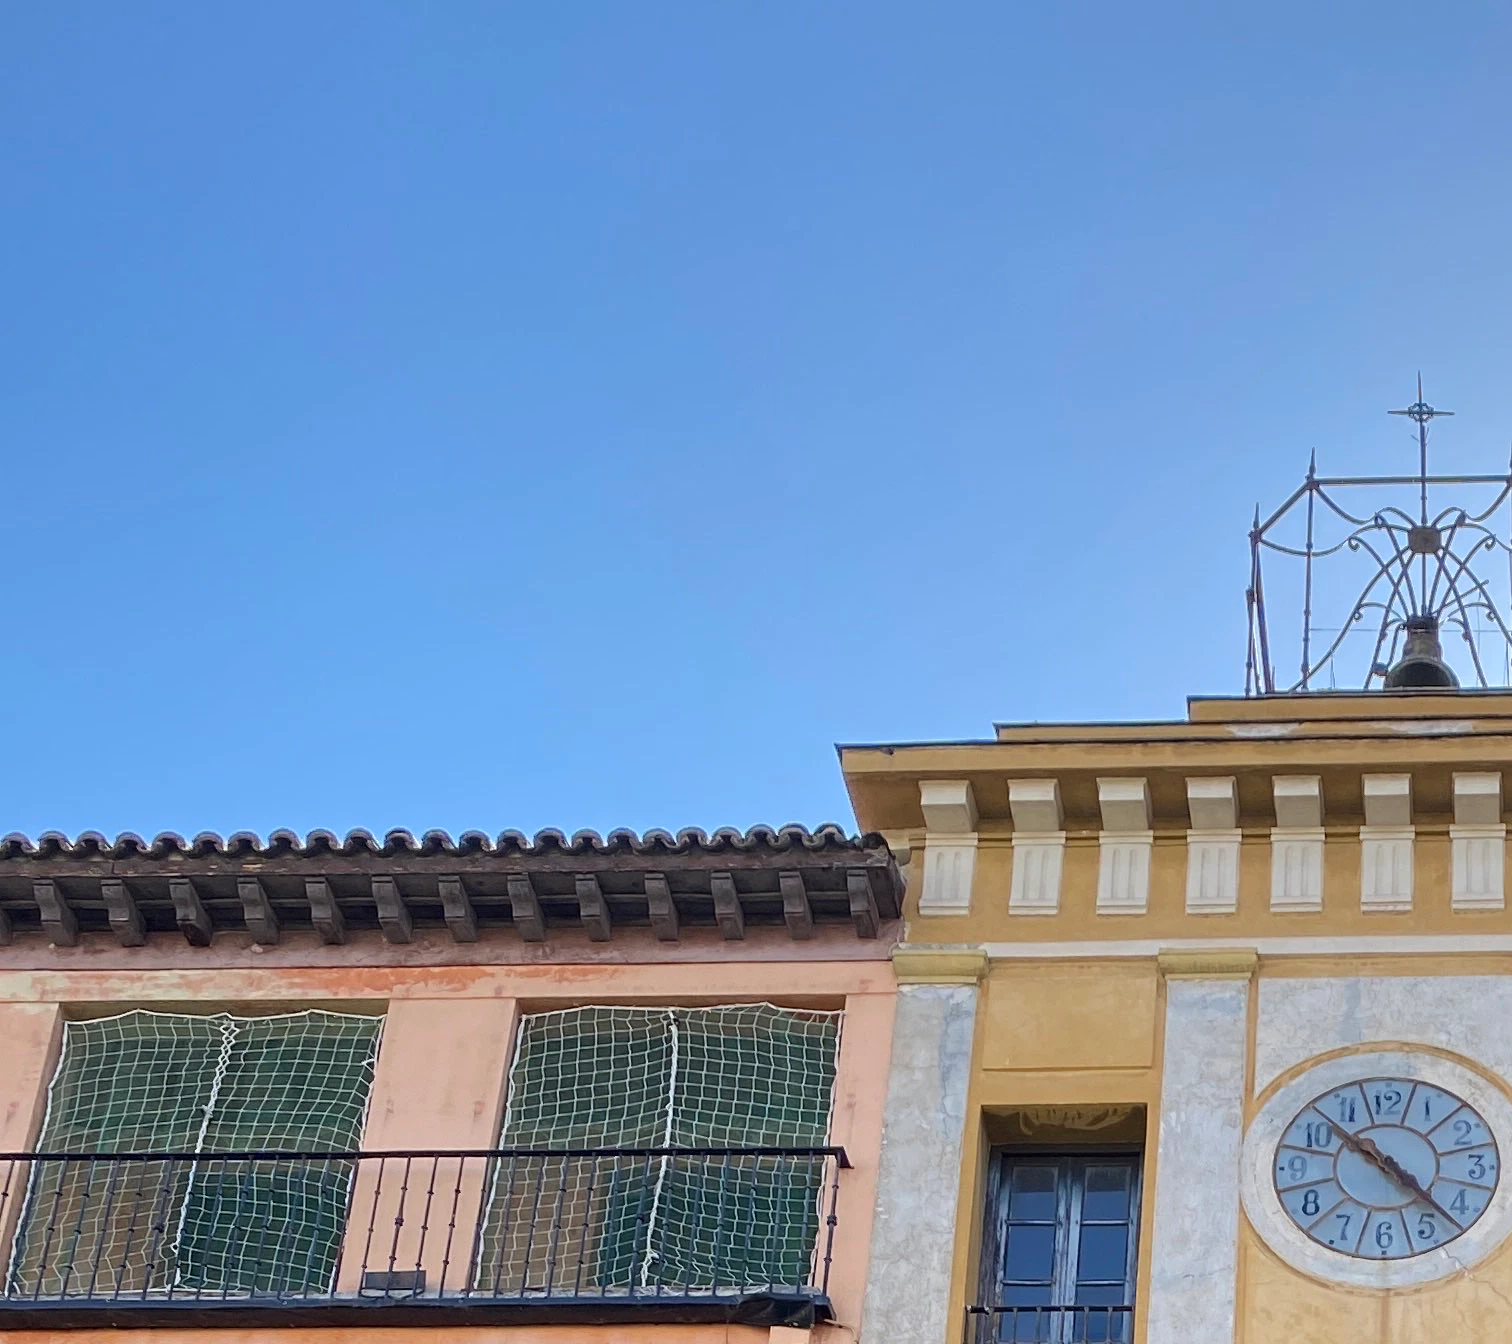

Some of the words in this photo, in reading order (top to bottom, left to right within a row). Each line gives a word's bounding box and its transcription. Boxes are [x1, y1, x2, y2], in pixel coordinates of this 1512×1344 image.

[1339, 1097, 1356, 1122] 11
[1373, 1090, 1402, 1116] 12
[1423, 1096, 1433, 1121] 1
[1305, 1122, 1333, 1147] 10
[1453, 1120, 1472, 1146] 2
[1287, 1155, 1308, 1181] 9
[1468, 1154, 1485, 1179] 3
[1301, 1189, 1320, 1216] 8
[1449, 1189, 1469, 1215] 4
[1336, 1214, 1350, 1240] 7
[1375, 1222, 1393, 1248] 6
[1417, 1213, 1436, 1239] 5
